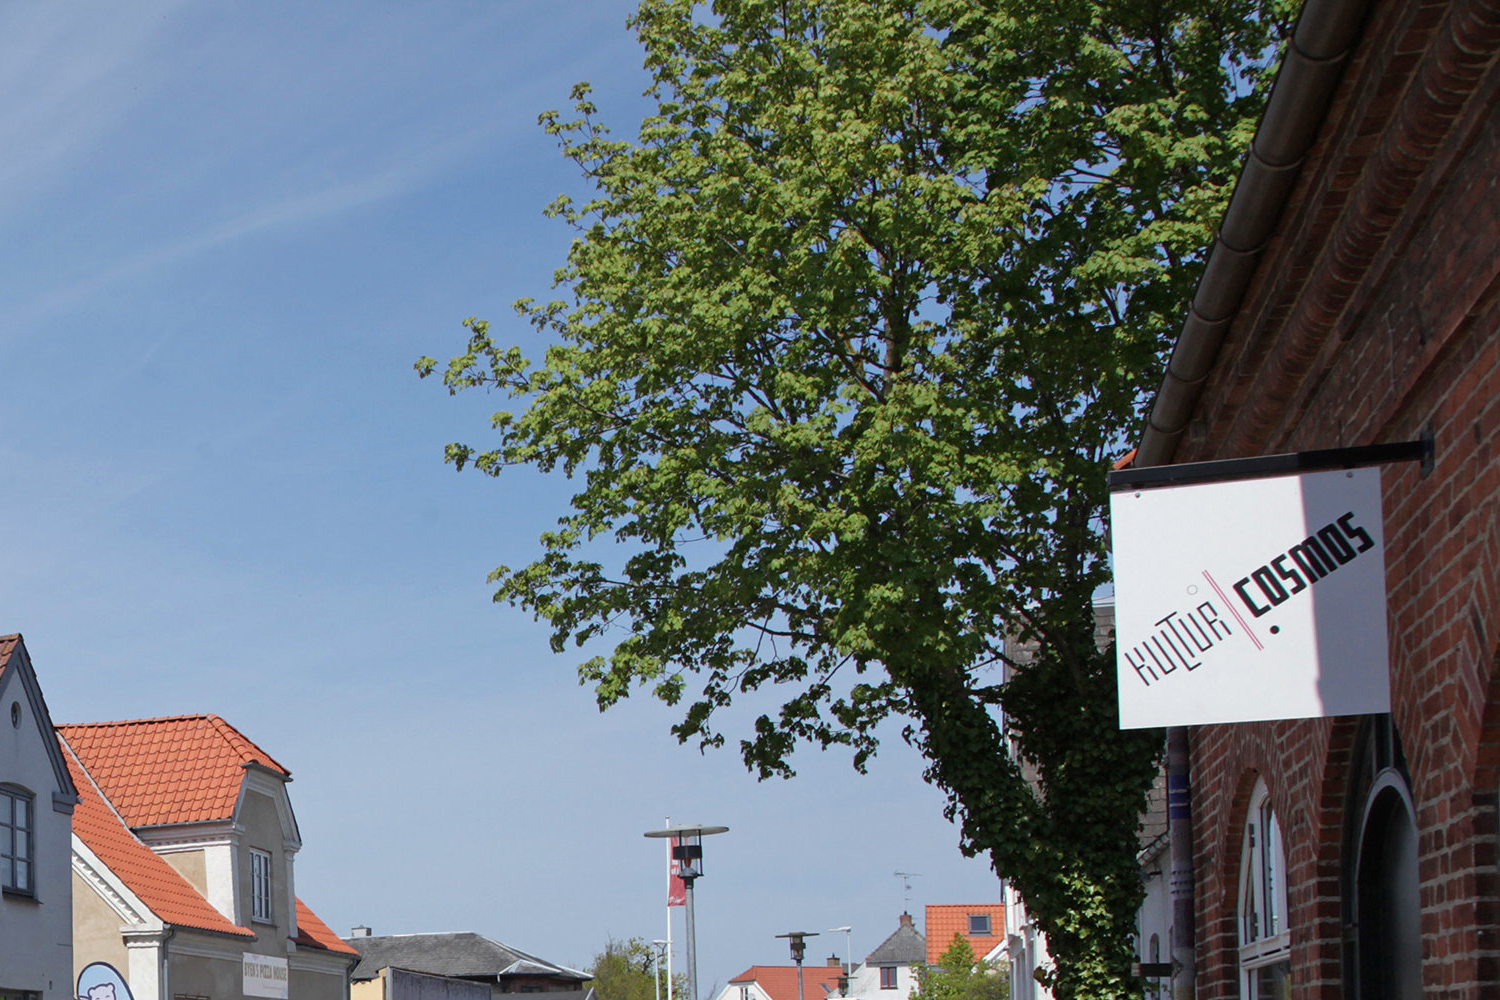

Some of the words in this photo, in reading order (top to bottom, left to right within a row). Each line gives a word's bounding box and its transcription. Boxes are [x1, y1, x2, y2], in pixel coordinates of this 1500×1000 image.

[1124, 601, 1232, 687] KULTUR
[1232, 511, 1376, 618] COSMOS
[259, 963, 272, 979] PIZZA
